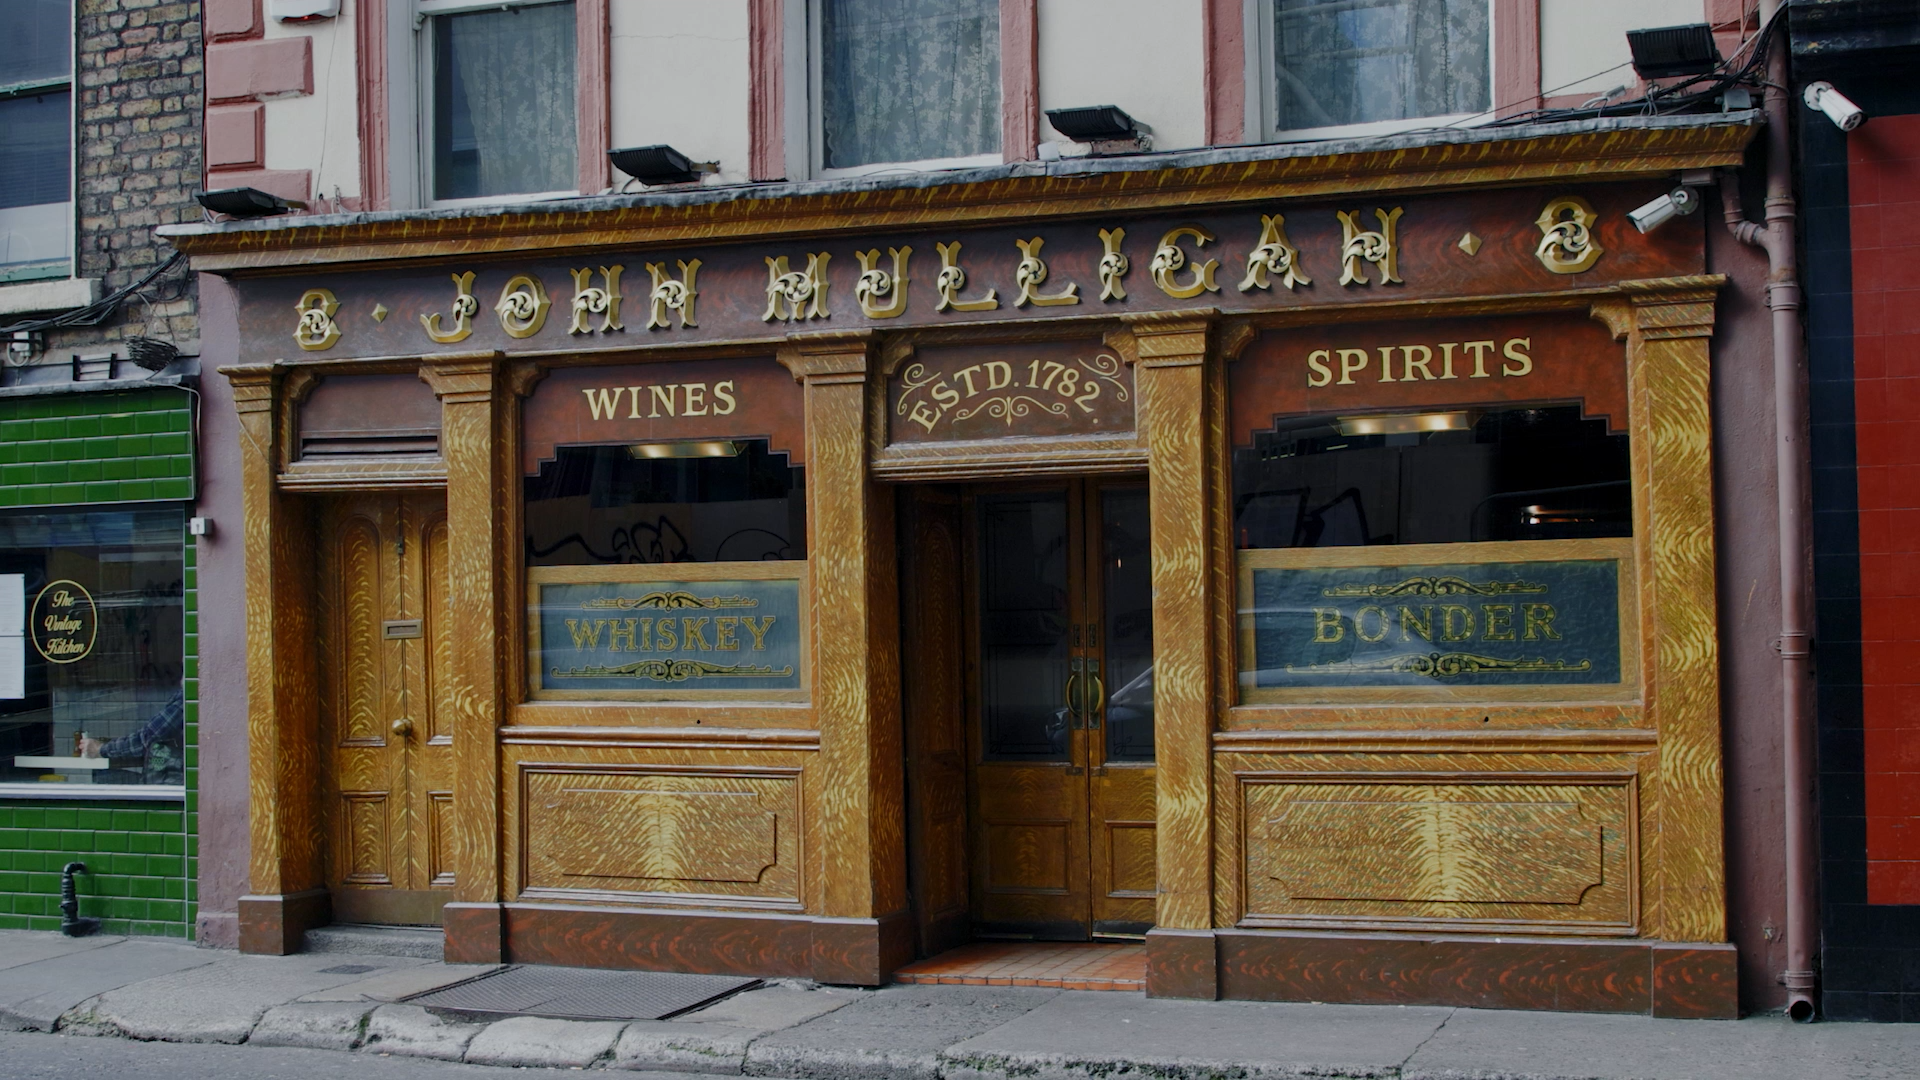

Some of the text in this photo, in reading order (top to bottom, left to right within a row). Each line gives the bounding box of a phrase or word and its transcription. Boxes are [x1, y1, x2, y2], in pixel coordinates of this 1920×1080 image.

[420, 258, 703, 343] JOHN
[762, 206, 1404, 322] MULLIGAN
[1307, 337, 1533, 388] SPIRITS
[582, 380, 737, 421] WINES
[52, 590, 75, 608] The
[45, 615, 83, 635] Vintage
[565, 615, 776, 652] WHISKEY
[1311, 602, 1562, 645] BONDER
[45, 639, 85, 655] Kitchen
